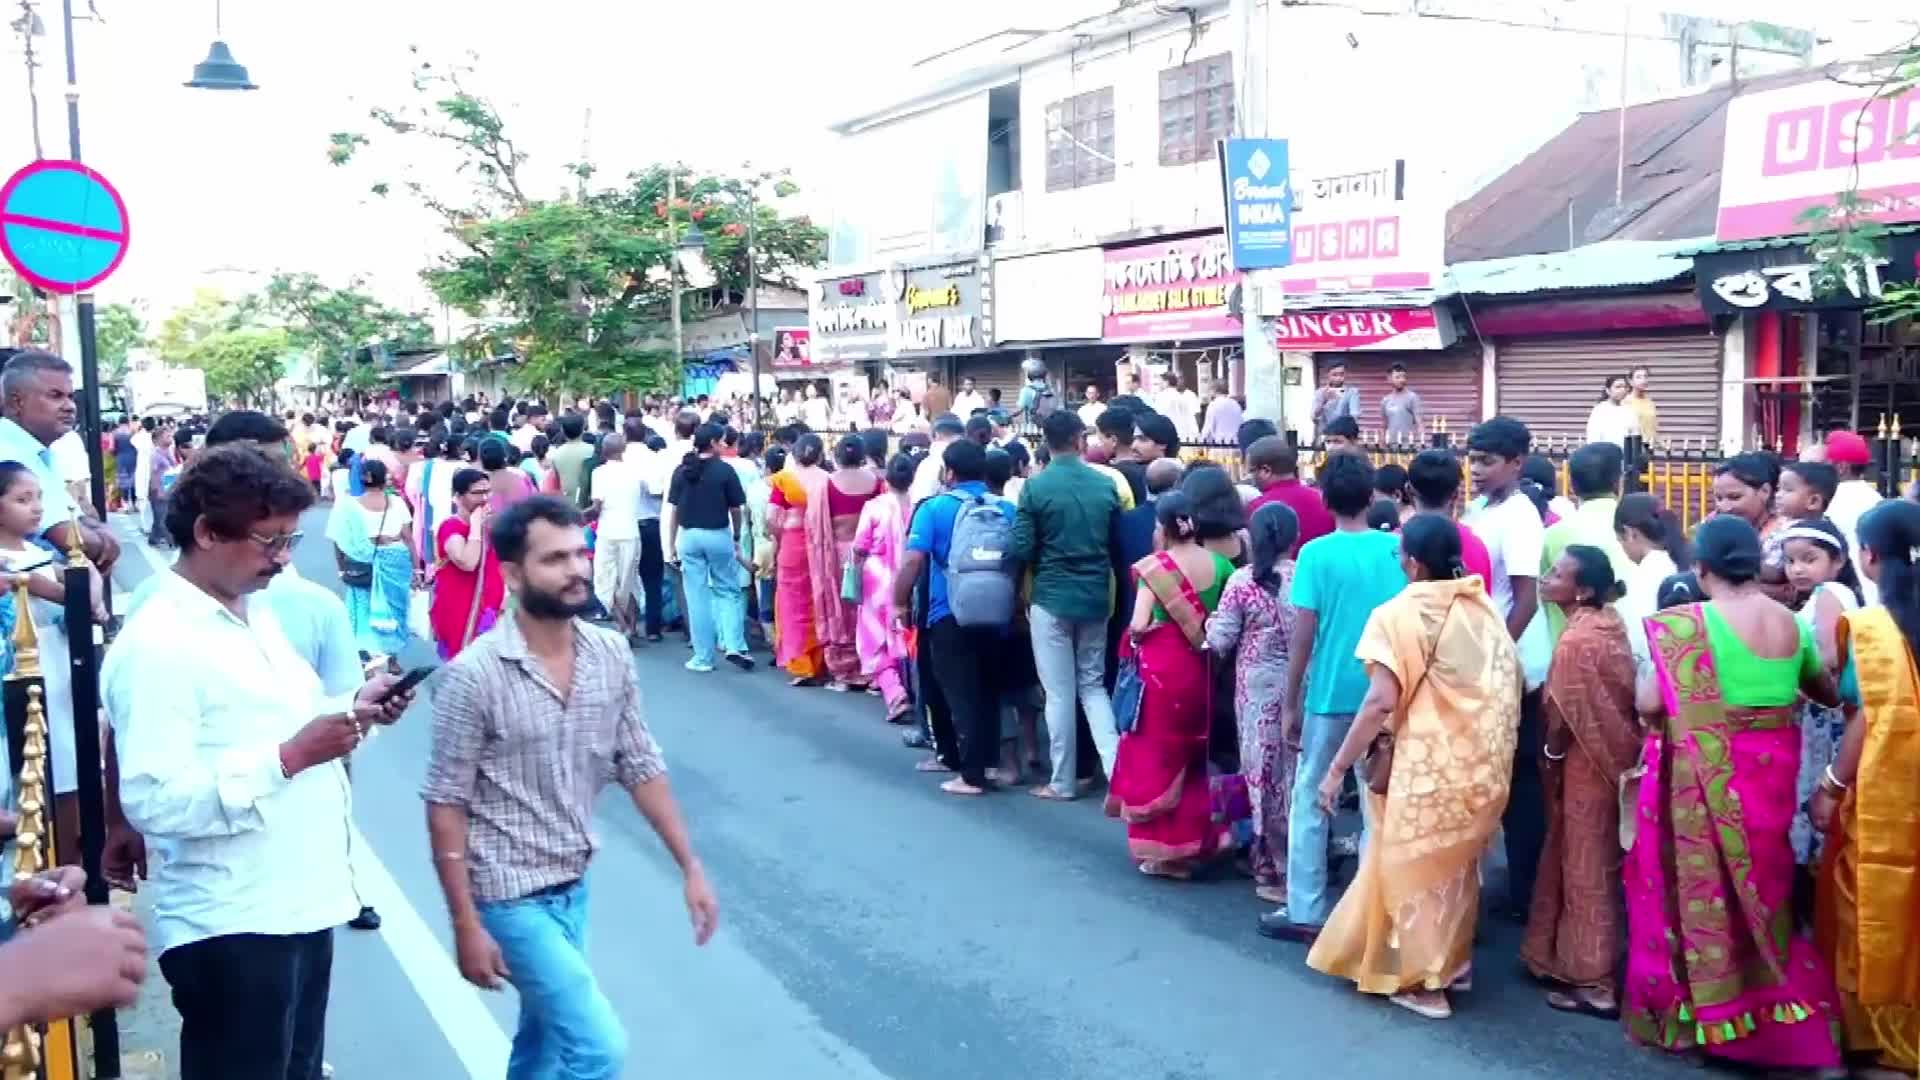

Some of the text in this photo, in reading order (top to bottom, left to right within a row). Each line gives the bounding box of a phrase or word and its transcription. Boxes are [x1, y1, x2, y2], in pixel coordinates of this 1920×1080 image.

[1234, 176, 1287, 201] Brand
[1238, 203, 1285, 225] INDIA
[1296, 222, 1396, 258] USHA
[1274, 311, 1400, 339] SINGER
